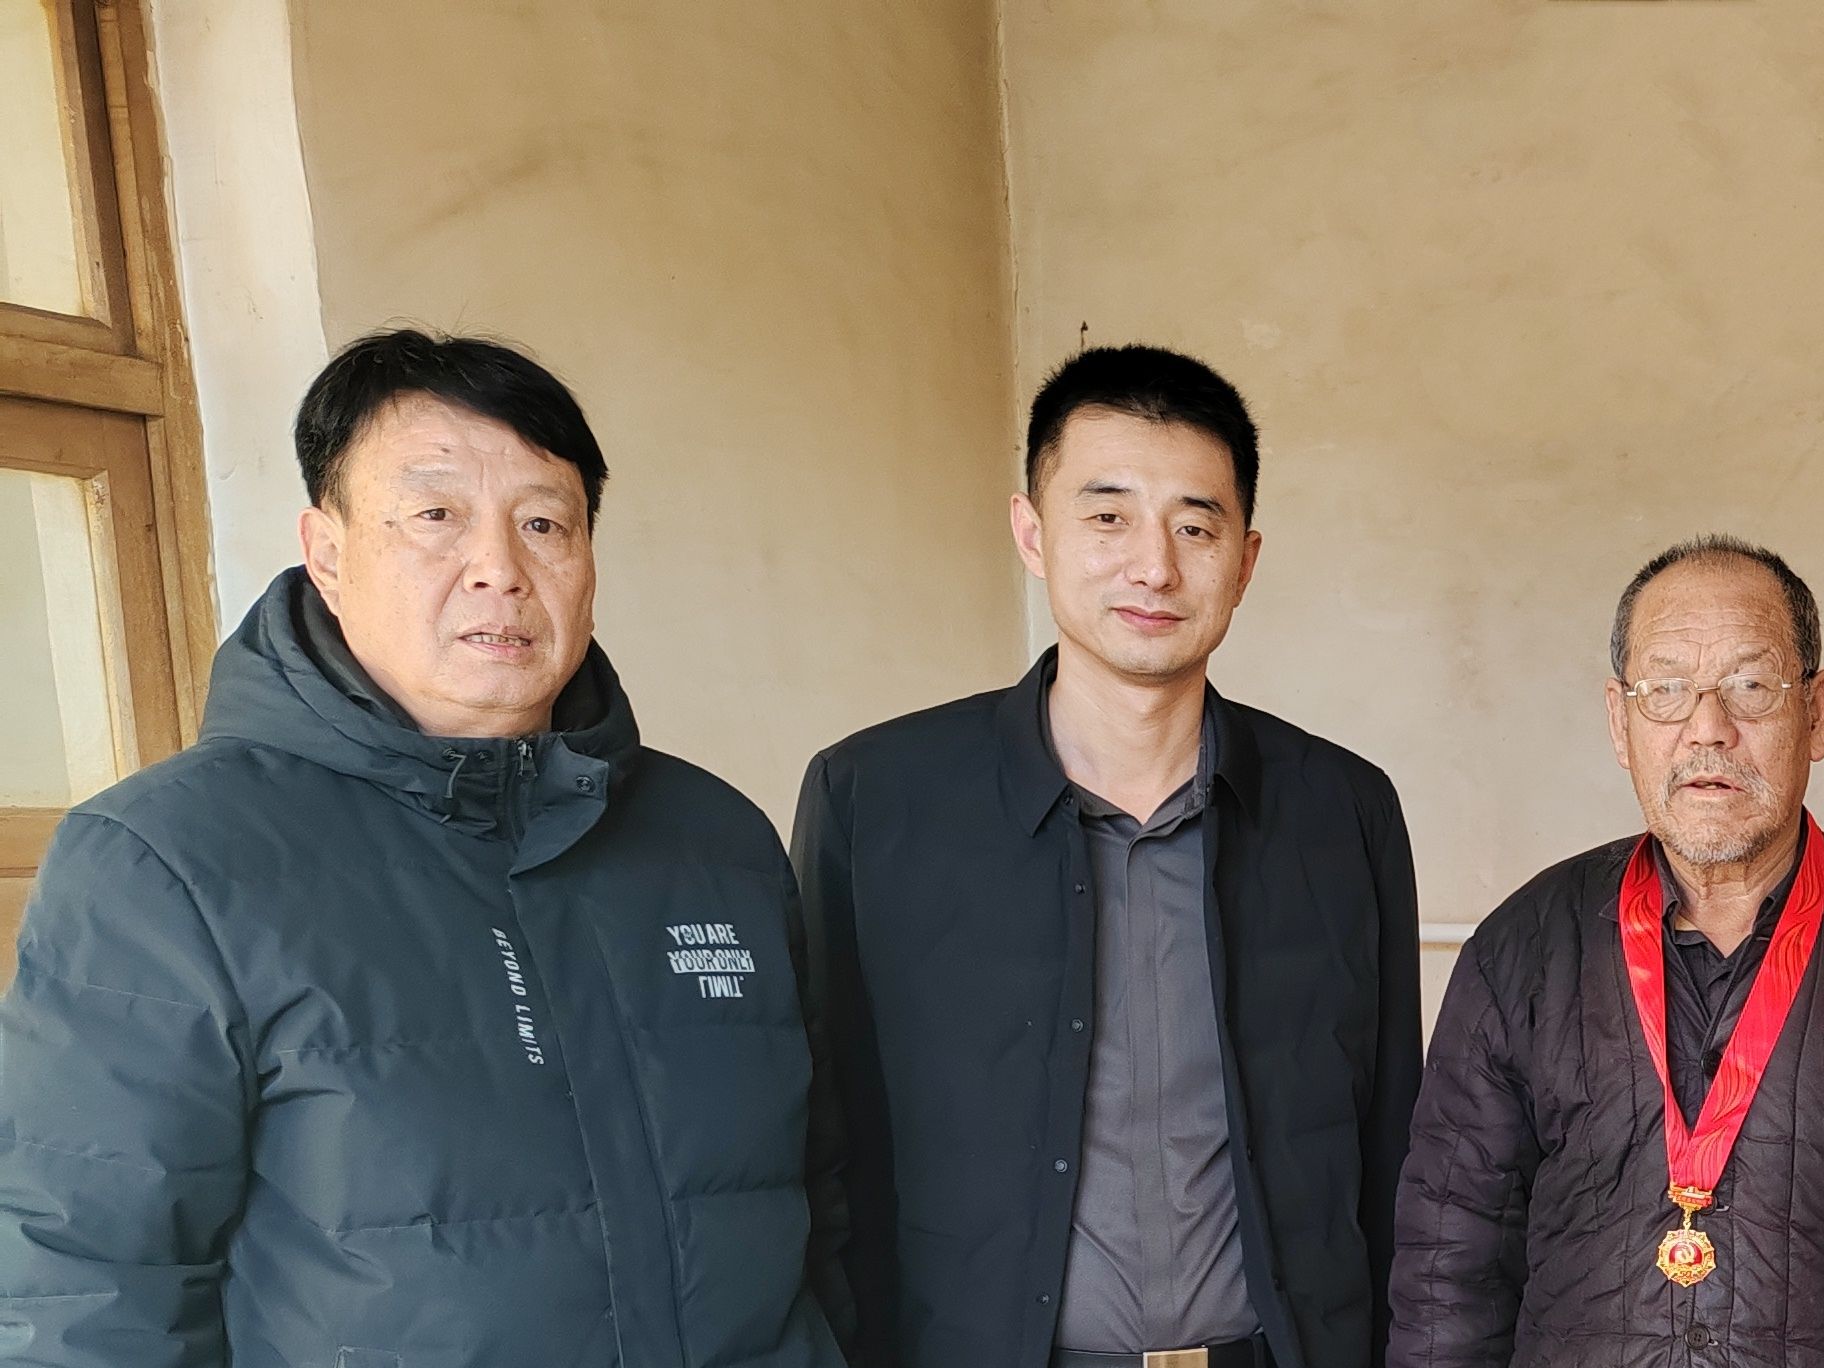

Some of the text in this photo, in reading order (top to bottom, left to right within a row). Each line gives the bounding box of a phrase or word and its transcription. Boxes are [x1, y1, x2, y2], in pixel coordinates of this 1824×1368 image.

[666, 923, 740, 945] YOU ARE
[667, 949, 755, 973] YOUR ONLY
[492, 927, 545, 1065] BEYOND LIMITS
